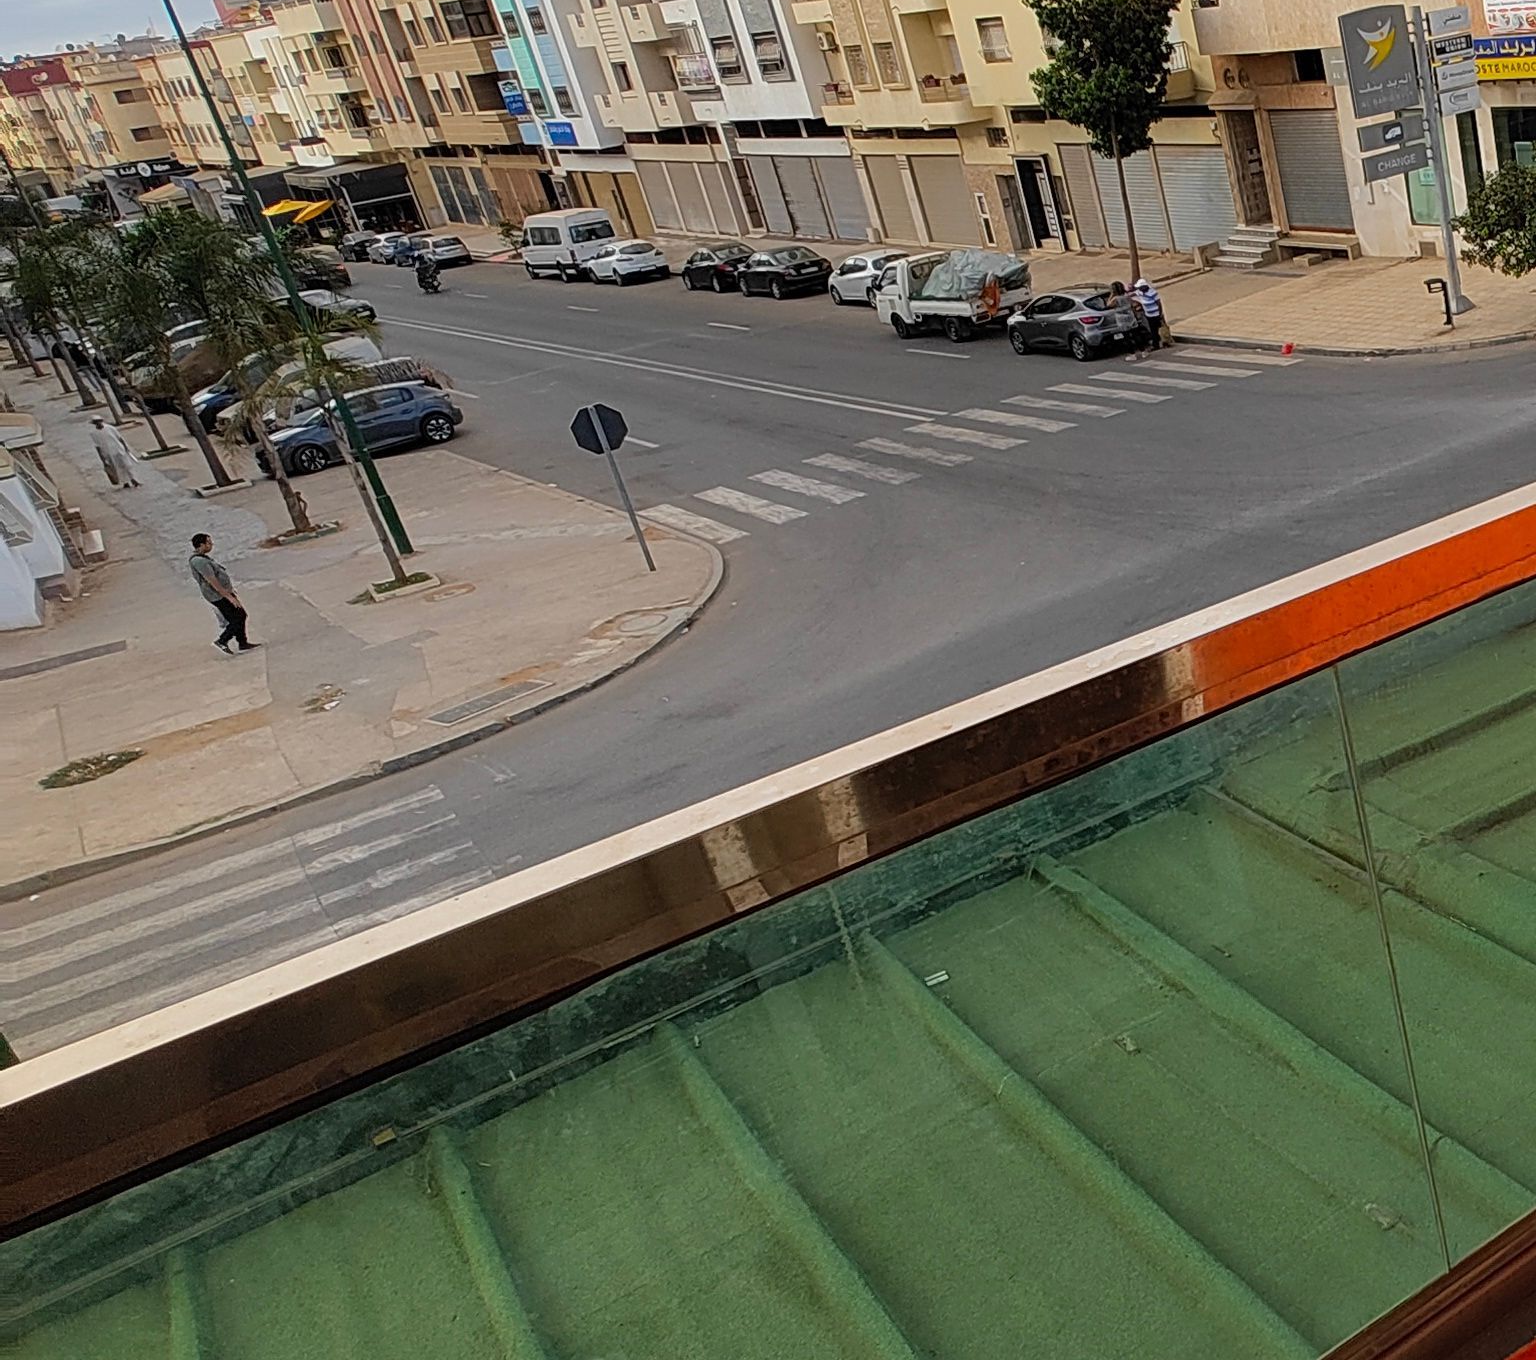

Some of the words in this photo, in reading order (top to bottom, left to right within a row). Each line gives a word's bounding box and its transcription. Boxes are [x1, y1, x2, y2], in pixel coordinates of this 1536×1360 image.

[1500, 39, 1536, 56] بريد
[1474, 63, 1501, 75] OSTE
[1377, 153, 1416, 172] CHANGE
